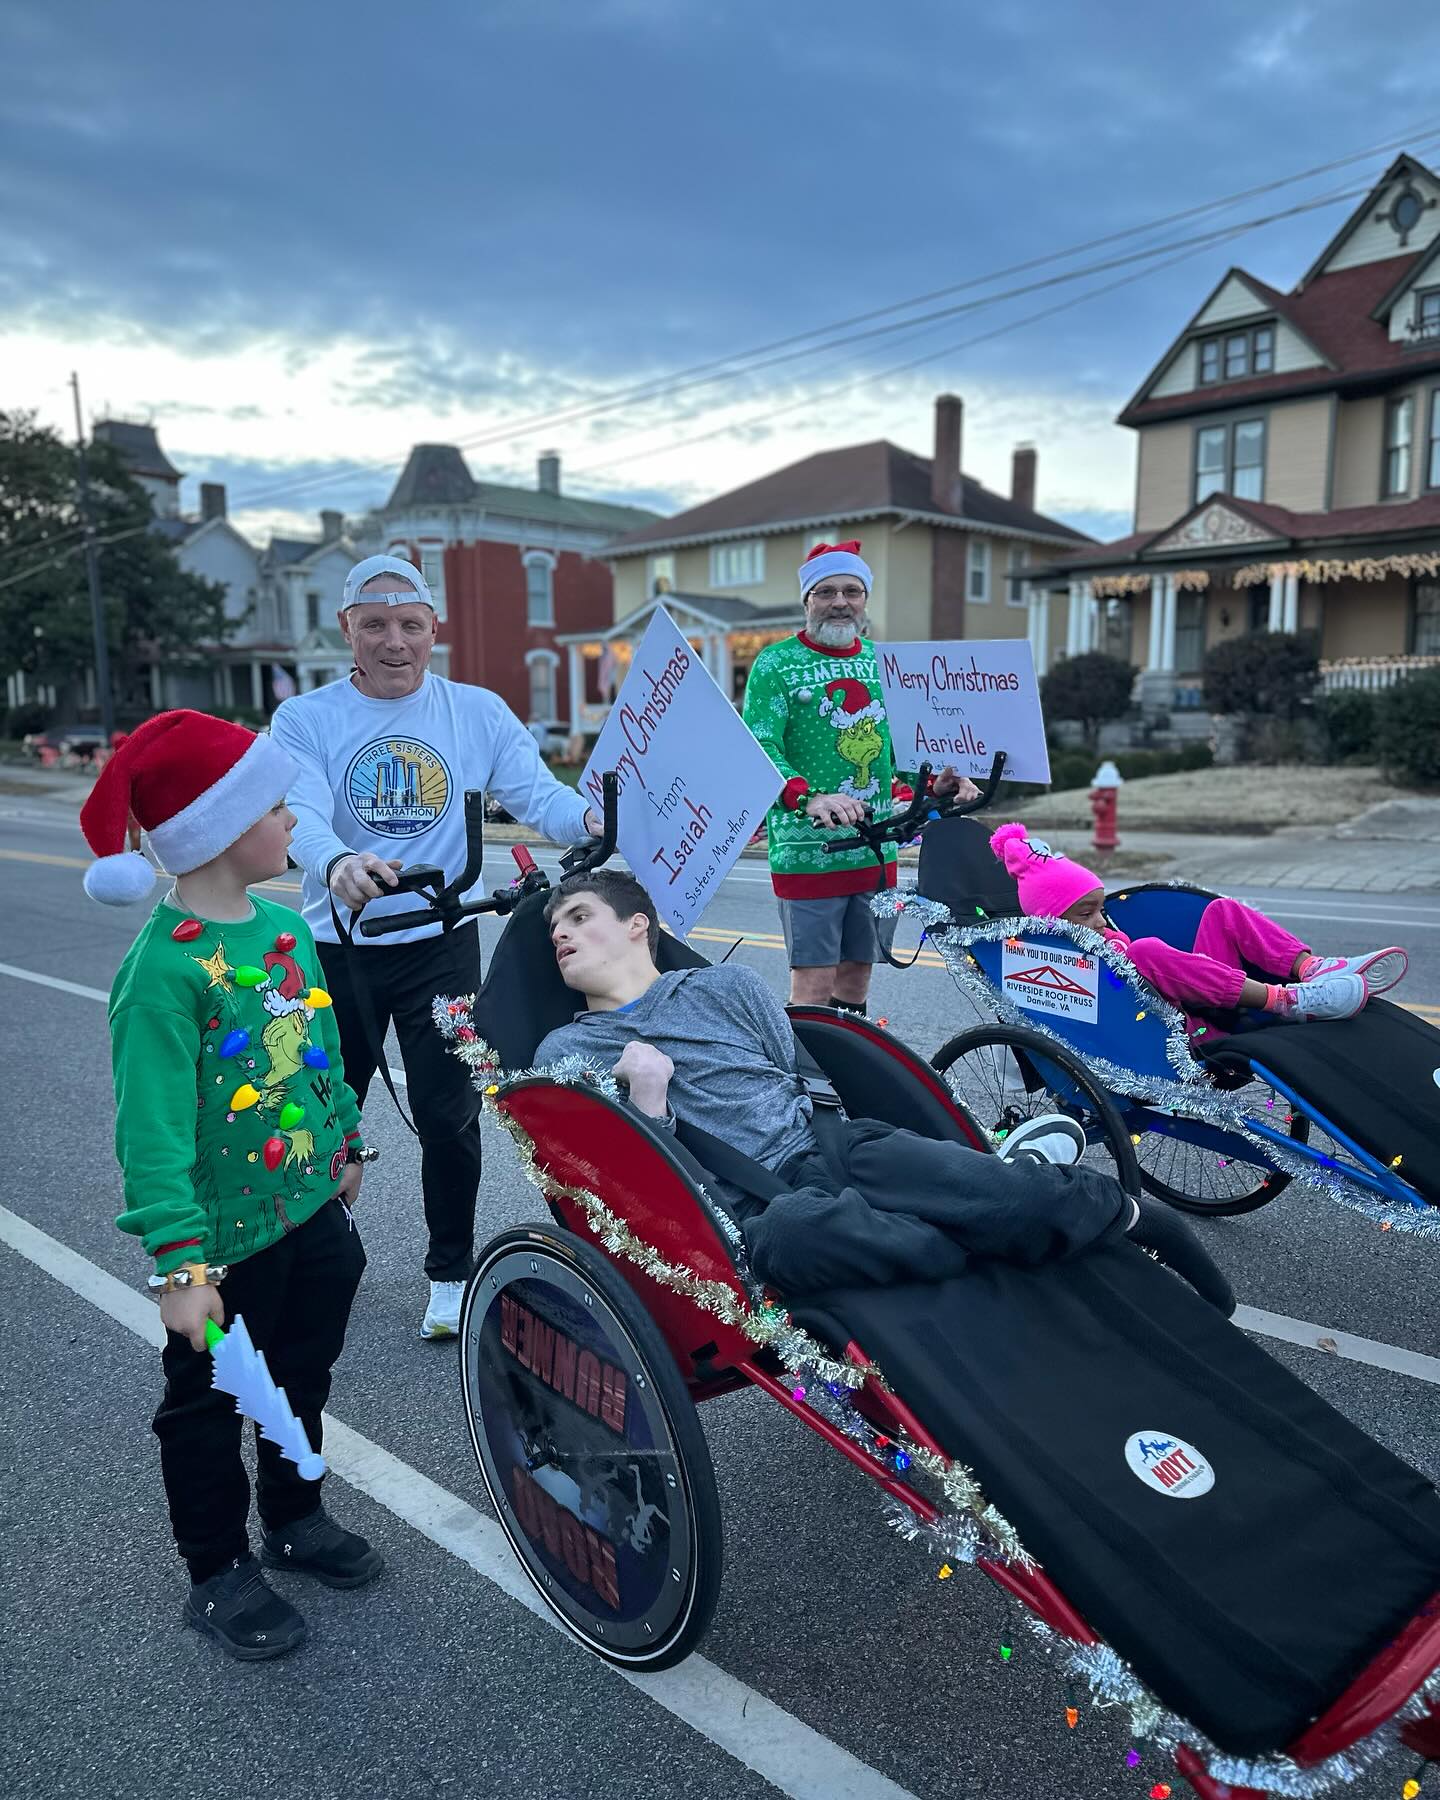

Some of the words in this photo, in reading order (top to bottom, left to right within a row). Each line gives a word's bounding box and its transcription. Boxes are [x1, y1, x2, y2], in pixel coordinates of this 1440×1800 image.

[813, 661, 875, 681] MERRY
[883, 653, 930, 701] Merry
[931, 655, 1019, 692] Christmas
[931, 695, 965, 717] from
[586, 747, 646, 812] Mrry
[619, 647, 691, 757] Christmas
[915, 722, 987, 756] Aarielle
[361, 743, 393, 768] THREE
[395, 743, 438, 769] SISTERS
[909, 759, 918, 770] 3
[376, 807, 433, 817] MARATHON
[647, 776, 687, 821] from
[652, 796, 713, 886] Isaiah
[673, 909, 685, 926] 3
[684, 864, 716, 907] Sisters
[711, 808, 750, 865] Marathon
[1005, 944, 1026, 957] THANK
[1026, 948, 1039, 960] YOU
[1040, 950, 1049, 961] TO
[1049, 952, 1063, 964] OUR
[1006, 981, 1044, 997] RIVERSIDE
[1045, 990, 1068, 1001] ROOF
[1070, 995, 1093, 1008] TRUSS
[1060, 1002, 1071, 1012] VA
[1151, 1447, 1197, 1488] HOYT
